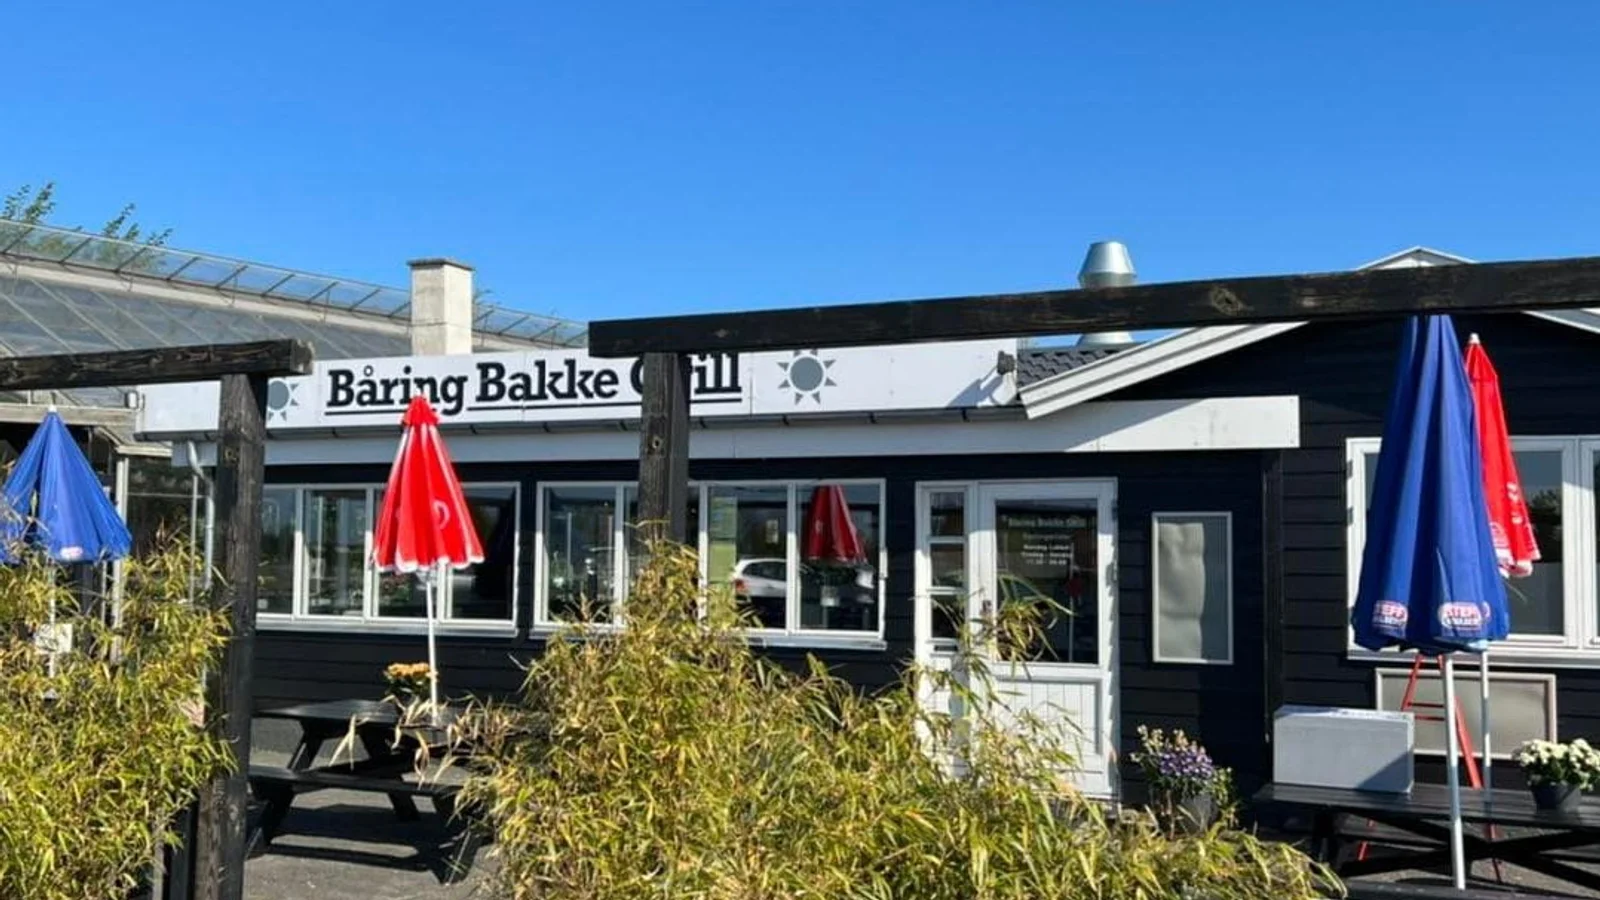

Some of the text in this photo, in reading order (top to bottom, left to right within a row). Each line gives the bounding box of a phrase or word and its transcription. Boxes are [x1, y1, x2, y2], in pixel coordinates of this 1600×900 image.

[326, 353, 743, 416] Båring Bakke ill
